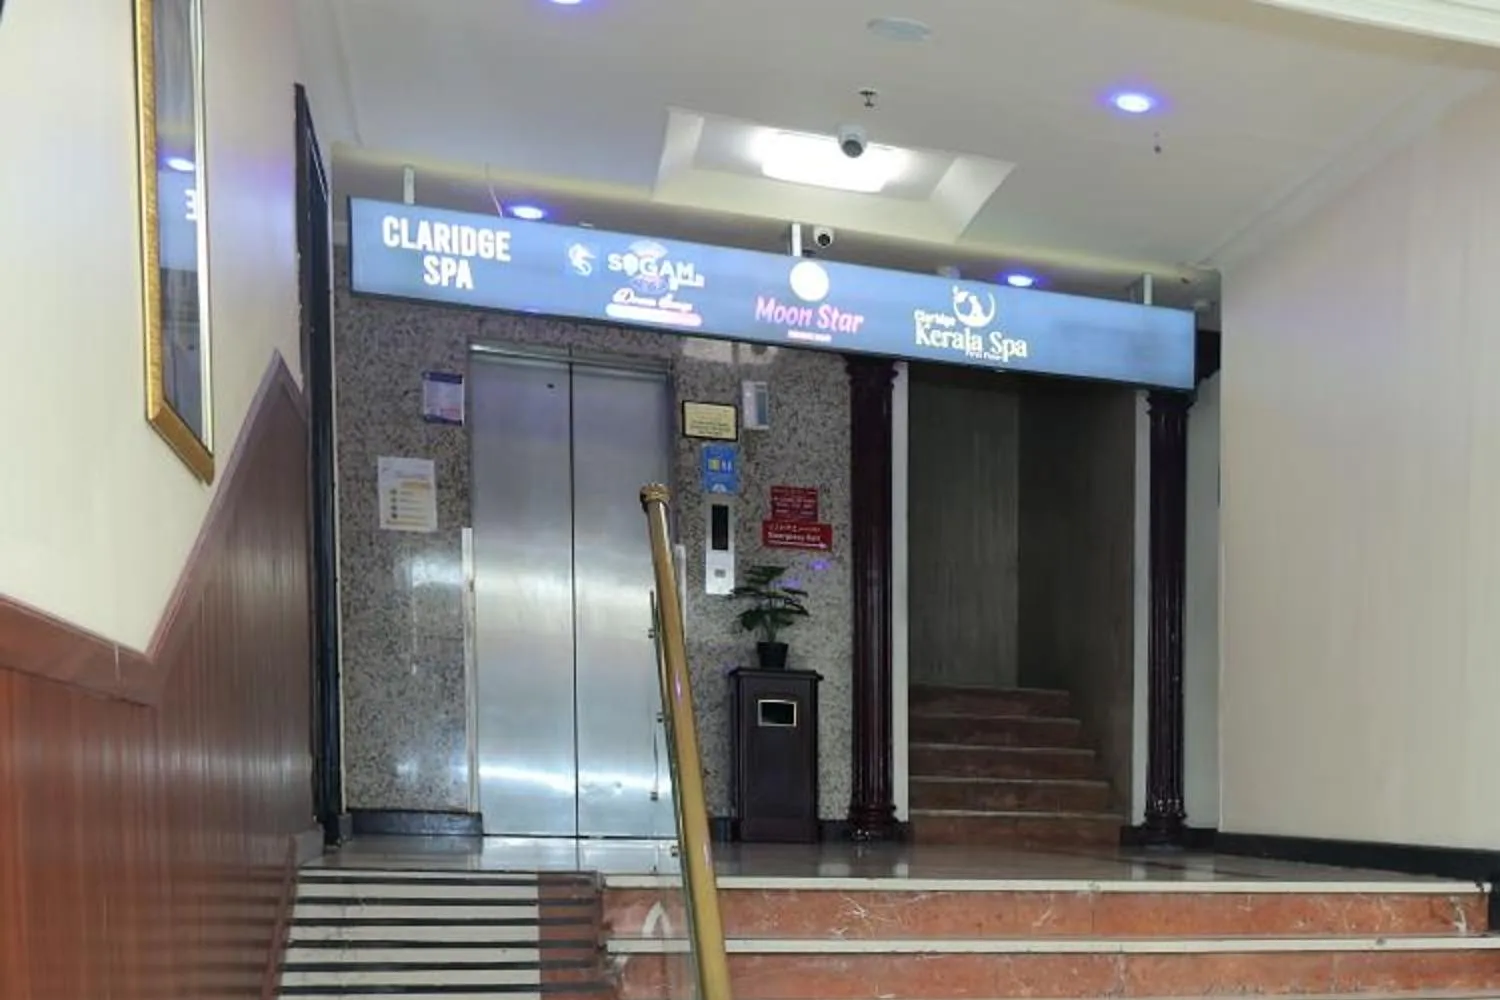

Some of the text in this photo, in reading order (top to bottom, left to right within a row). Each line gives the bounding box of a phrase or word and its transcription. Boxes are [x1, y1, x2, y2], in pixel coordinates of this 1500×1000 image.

[382, 215, 511, 262] CLARIDGE
[423, 254, 474, 289] SPA
[607, 253, 695, 281] SOGAM
[755, 296, 863, 334] Moon Star
[915, 323, 1028, 362] Kerala Spa
